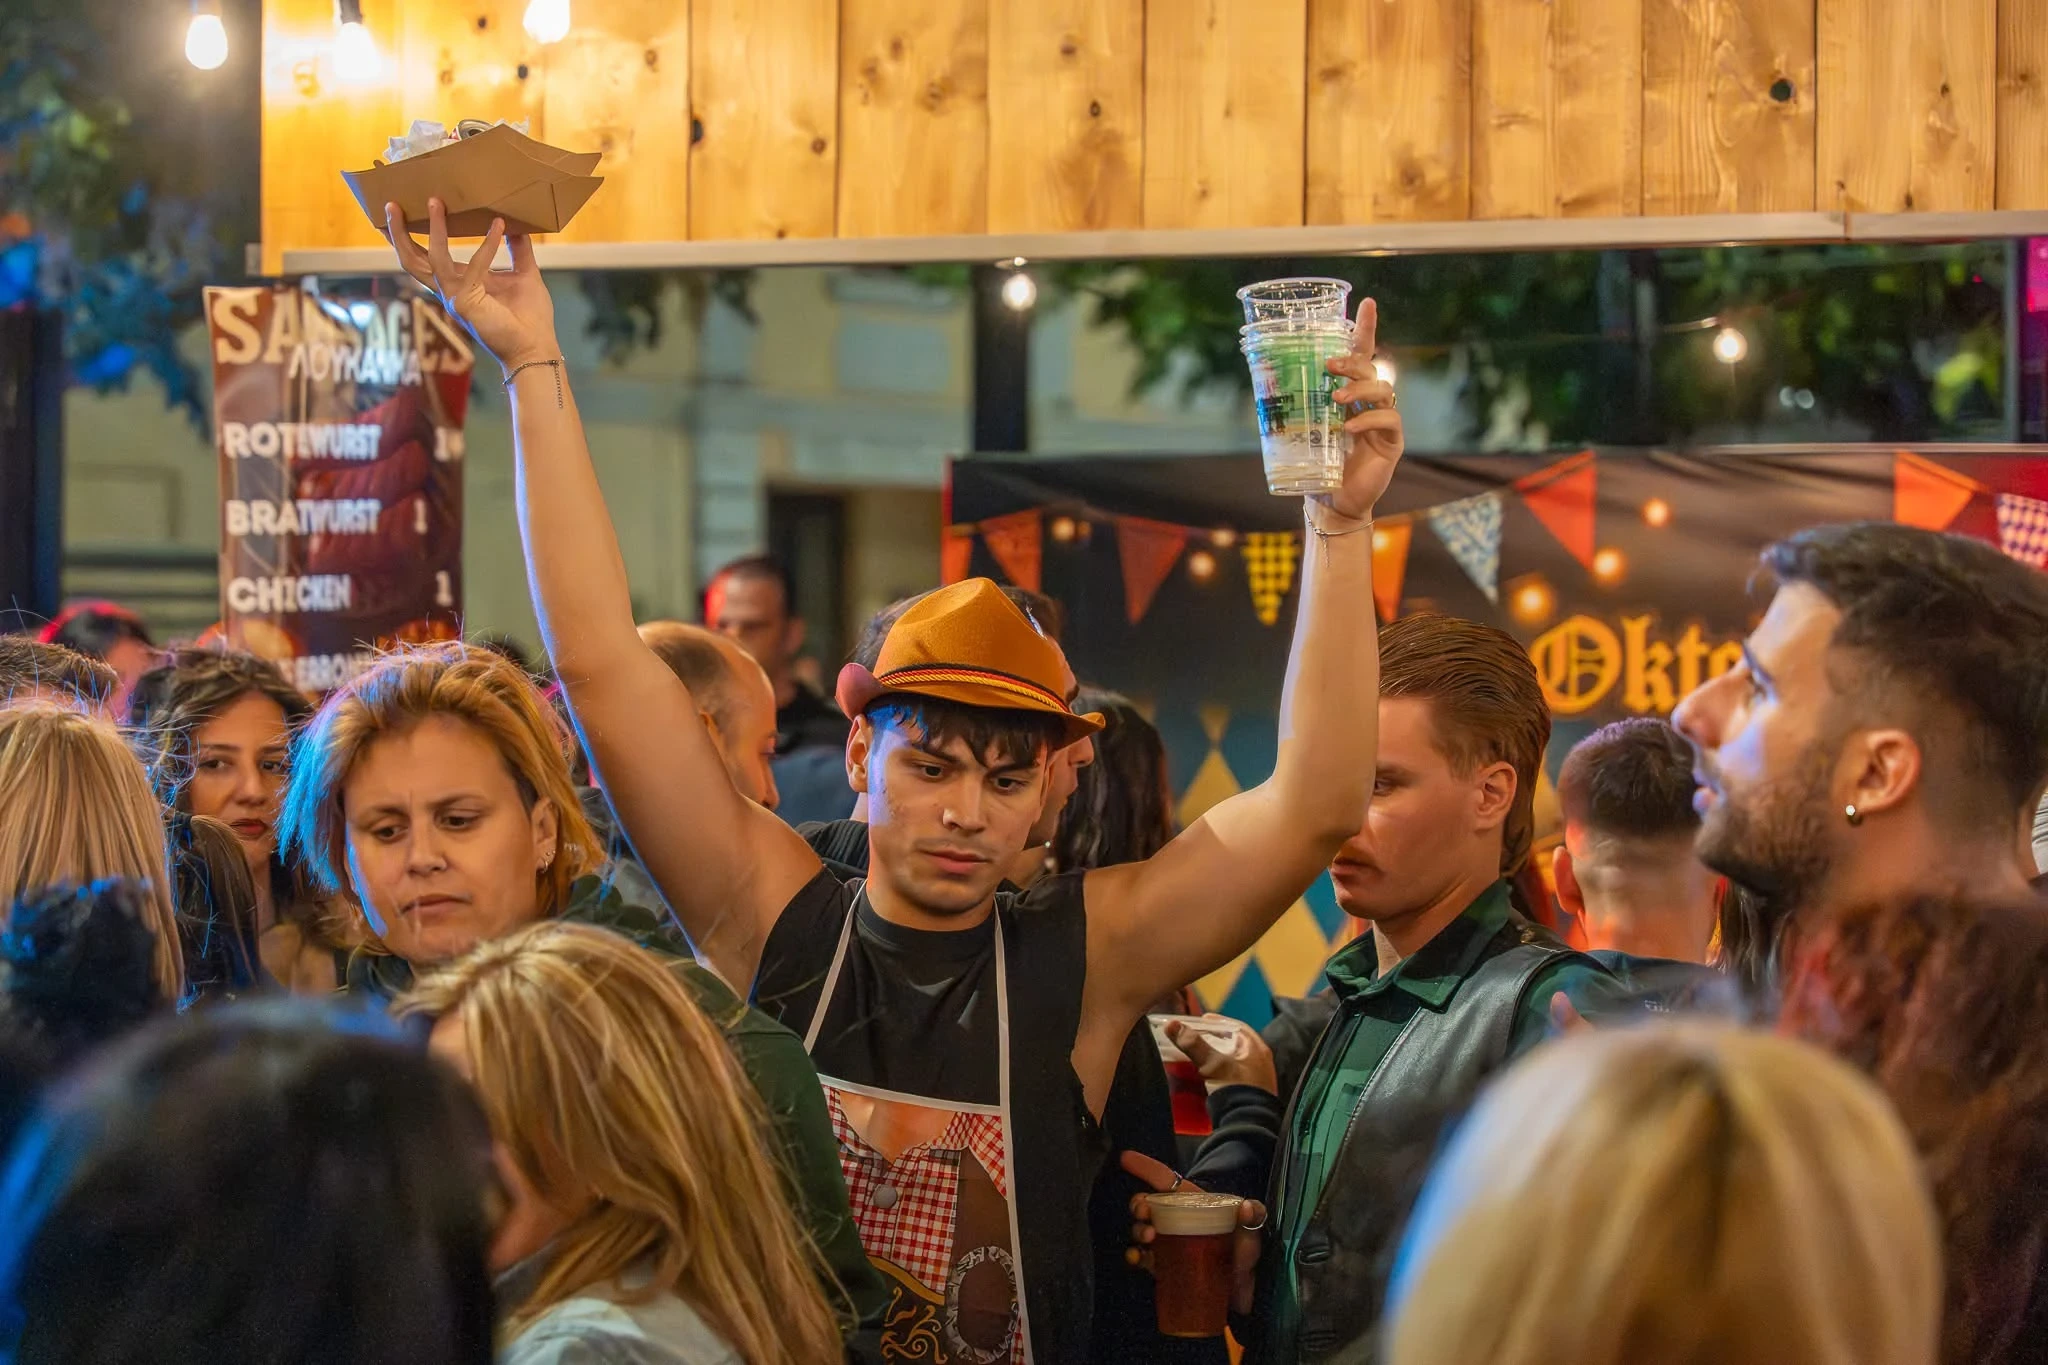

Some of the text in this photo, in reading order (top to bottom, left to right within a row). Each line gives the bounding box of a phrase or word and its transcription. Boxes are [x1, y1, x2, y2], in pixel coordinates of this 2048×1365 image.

[222, 422, 382, 461] ROTEWURST
[225, 498, 382, 536] BRATWURST
[227, 574, 352, 614] CHICKEN
